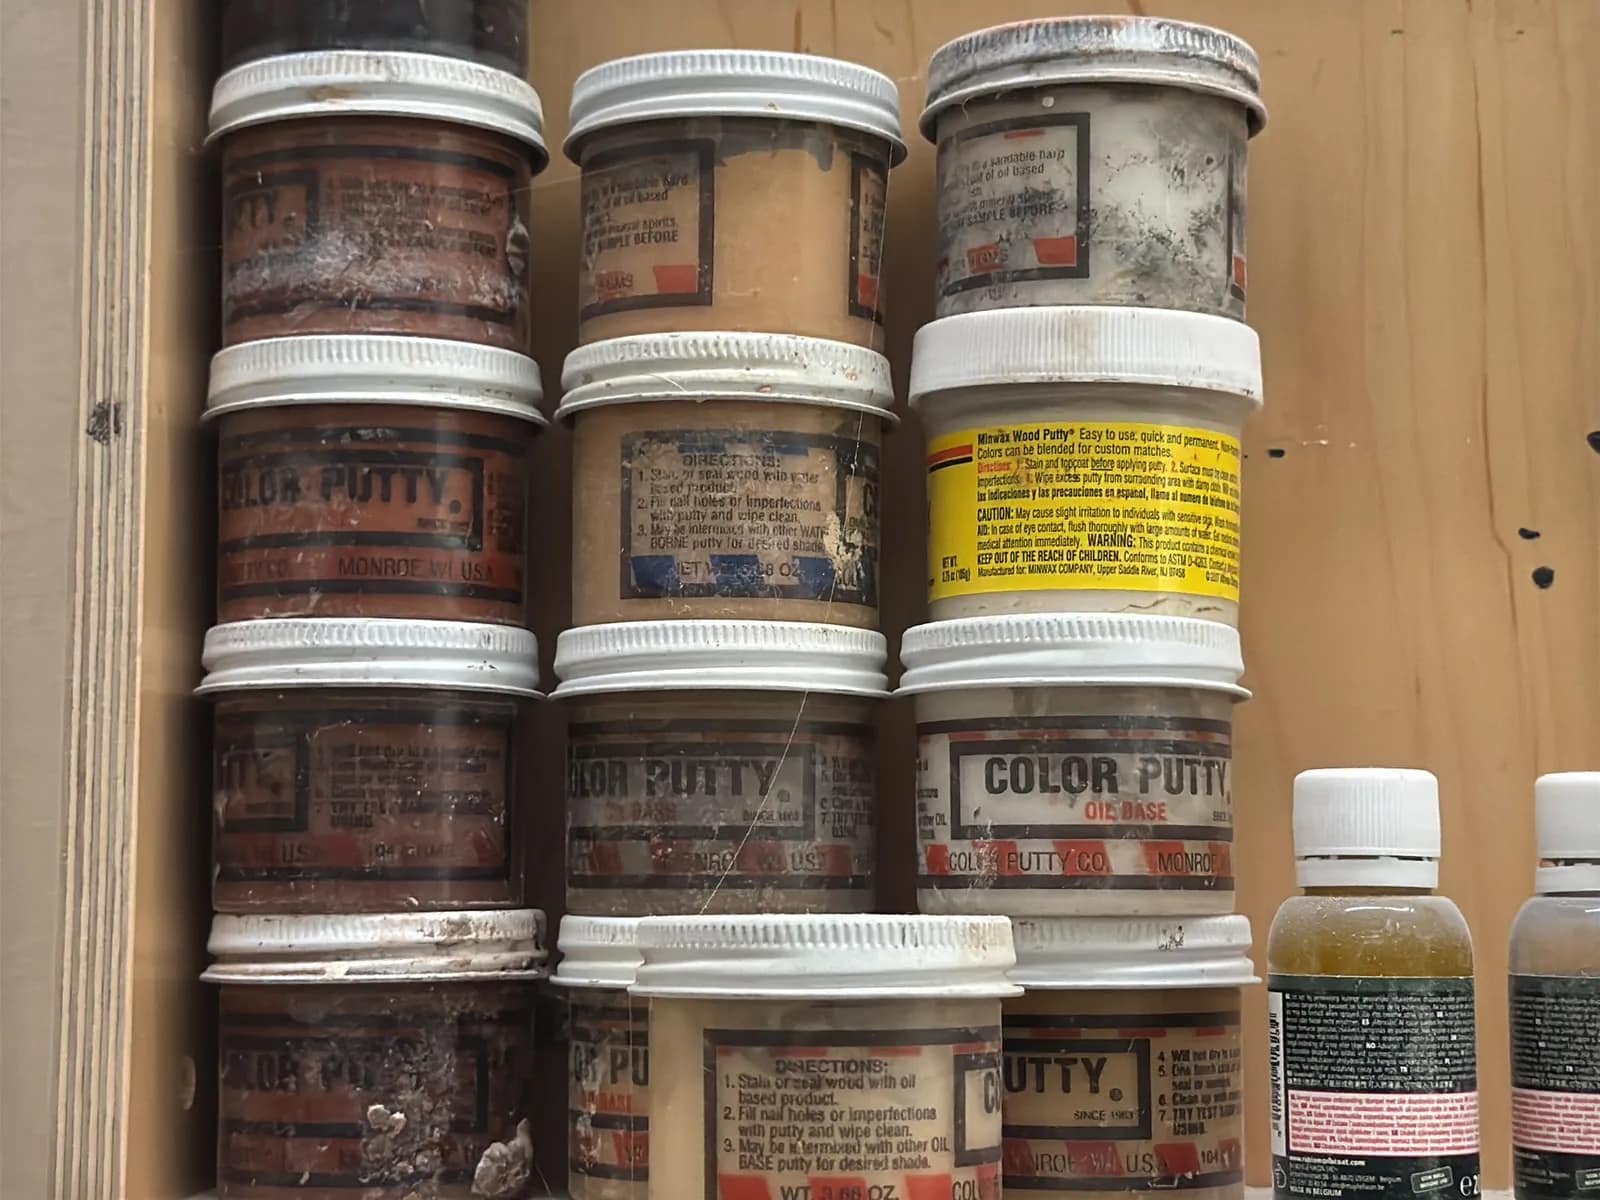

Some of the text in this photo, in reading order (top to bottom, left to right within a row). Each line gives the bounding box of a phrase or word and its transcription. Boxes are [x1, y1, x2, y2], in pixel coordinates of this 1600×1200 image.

[1012, 164, 1044, 177] based
[634, 230, 678, 244] BEFORE
[978, 428, 1181, 444] Minwax Wood Easy to quick and
[978, 442, 1172, 459] Colors can be blended for custom matches.
[1025, 458, 1043, 469] Stain
[1046, 458, 1058, 468] and
[1171, 462, 1178, 472] 2.
[1083, 473, 1102, 483] putty
[1104, 473, 1121, 483] from
[1124, 473, 1165, 487] surrounding
[1032, 490, 1036, 500] y
[1038, 487, 1049, 498] las
[1052, 485, 1103, 499] precauciones
[637, 499, 650, 509] 2.
[711, 509, 732, 521] and
[978, 507, 1013, 522] CAUTION:
[1016, 508, 1030, 520] May
[1033, 508, 1053, 518] cause
[1056, 506, 1076, 520] slight
[1079, 506, 1110, 518] irritation
[1113, 508, 1120, 518] to
[1122, 506, 1159, 520] individuals
[1000, 525, 1013, 534] case
[1016, 523, 1022, 533] of
[1024, 524, 1035, 535] eye
[1038, 523, 1066, 533] contact,
[1068, 521, 1086, 532] flush
[1130, 523, 1144, 533] with
[1035, 536, 1082, 549] immediately.
[1088, 533, 1136, 548] WARNING:
[1140, 537, 1153, 549] This
[1156, 539, 1180, 552] product
[978, 552, 992, 564] KEEP
[995, 552, 1008, 563] OUT
[1010, 552, 1019, 562] OF
[1022, 551, 1036, 562] THE
[1038, 550, 1063, 561] REACH
[1068, 550, 1076, 560] OF
[1079, 550, 1121, 562] CHILDREN.
[1124, 551, 1157, 563] Conforms
[339, 557, 419, 578] MONROE
[1029, 564, 1056, 574] MINWAX
[1058, 564, 1095, 575] COMPANY,
[1097, 564, 1116, 576] Upper
[646, 760, 777, 796] PUTTY
[984, 756, 1225, 796] COLOR PUTTY
[1085, 801, 1167, 822] OIL BASE
[1008, 851, 1069, 871] PUTTY
[610, 1047, 649, 1086] PU
[776, 1060, 888, 1073] DIRECTIONS:
[725, 1076, 735, 1088] 1.
[776, 1077, 788, 1088] or
[826, 1075, 863, 1088] wood
[868, 1075, 896, 1089] with
[901, 1074, 915, 1088] oil
[1004, 1057, 1107, 1094] UTTY
[739, 1091, 776, 1105] based
[724, 1108, 736, 1120] 2.
[739, 1108, 756, 1120] Fill
[788, 1108, 824, 1121] holes
[830, 1110, 845, 1121] or
[849, 1108, 936, 1123] imperfections
[739, 1124, 912, 1141] with putty and wipe clean.
[724, 1140, 734, 1153] 3.
[739, 1139, 765, 1155] May
[769, 1139, 785, 1153] be
[865, 1141, 891, 1154] with
[896, 1140, 928, 1154] other
[739, 1156, 773, 1170] BASE
[778, 1157, 811, 1173] putty
[816, 1156, 834, 1170] for
[839, 1156, 888, 1170] desired
